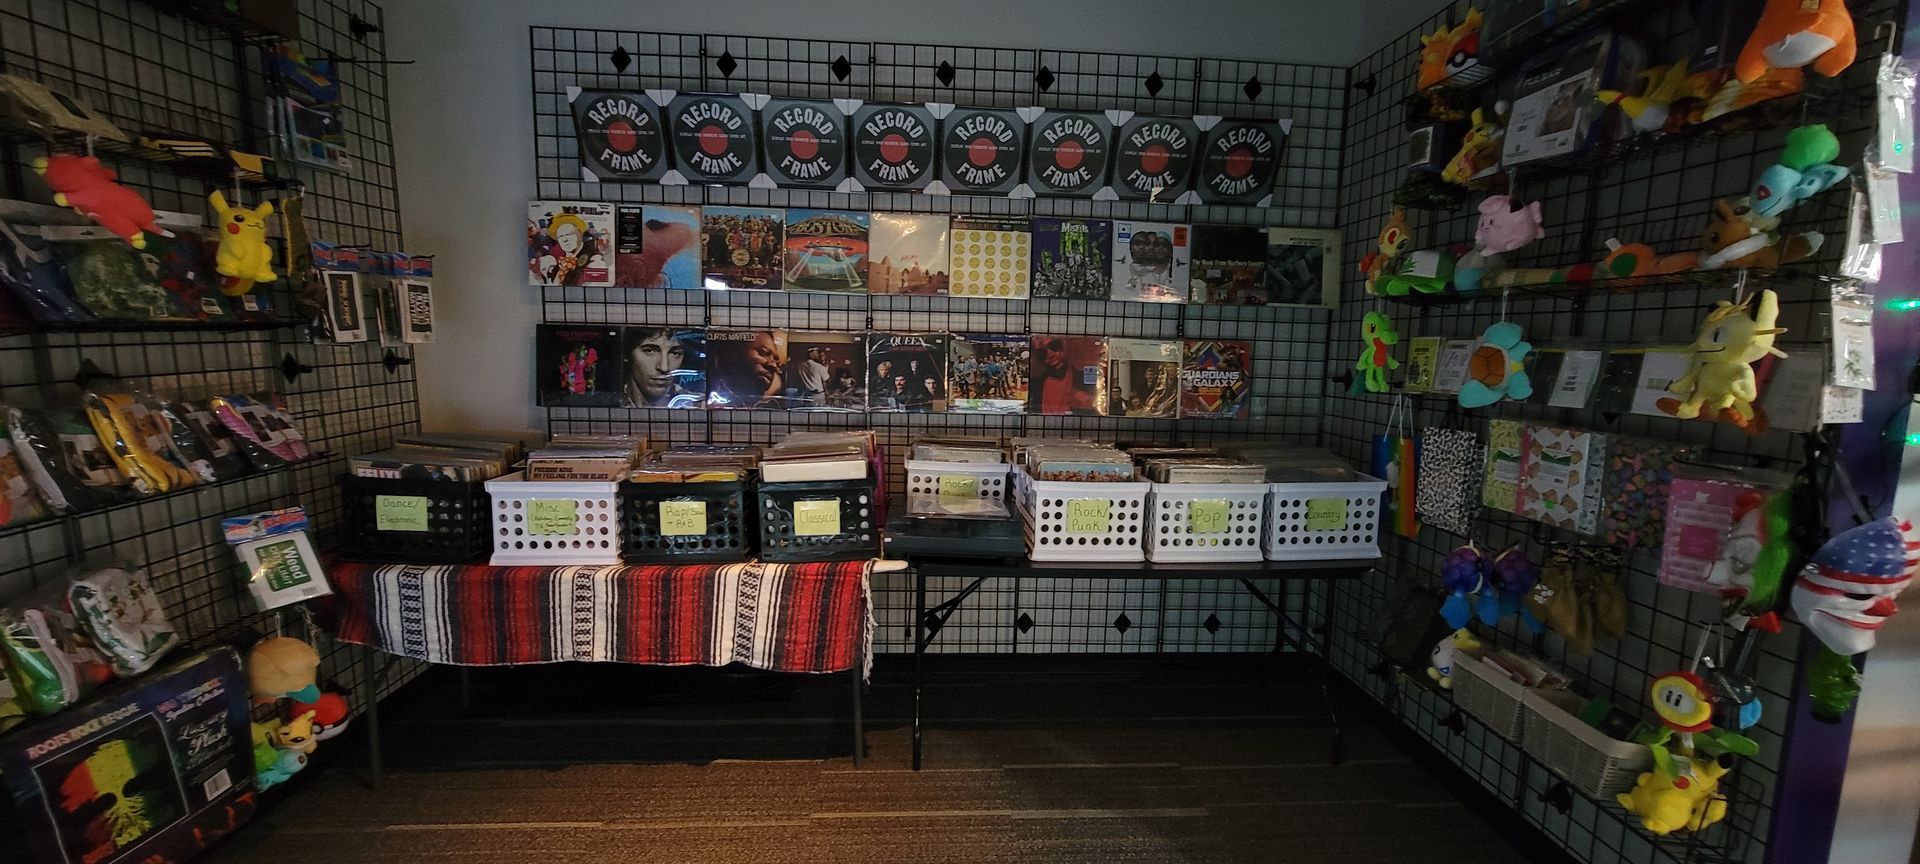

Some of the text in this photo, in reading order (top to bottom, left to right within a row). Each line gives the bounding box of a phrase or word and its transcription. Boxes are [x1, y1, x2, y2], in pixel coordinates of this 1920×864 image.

[588, 99, 649, 127] RECORD
[681, 102, 742, 130] RECORD
[774, 107, 833, 135] RECORD
[865, 111, 924, 139] RECORD
[955, 114, 1013, 143] RECORD
[1043, 118, 1101, 146] RECORD
[1131, 123, 1187, 150] RECORD
[1217, 127, 1271, 154] RECORD
[600, 148, 653, 172] FRAME
[690, 151, 743, 174] FRAME
[780, 154, 831, 178] FRAME
[869, 158, 920, 181] FRAME
[956, 162, 1006, 185] FRAME
[1042, 165, 1091, 187] FRAME
[1127, 169, 1175, 191] FRAME
[1211, 173, 1258, 195] FRAME
[707, 333, 728, 341] CURTIS
[890, 336, 927, 347] QUEEN
[1182, 369, 1240, 380] GUARDIANS
[1193, 379, 1238, 388] GALAXY
[800, 506, 837, 524] Classical
[1074, 502, 1109, 518] Rock/
[1195, 508, 1221, 530] Pop
[1307, 508, 1341, 525] Country
[1072, 519, 1102, 532] Punk
[281, 546, 308, 580] Weed
[278, 565, 293, 585] LIMIT
[26, 702, 141, 760] ROOTS ROCK REGGAE
[188, 723, 228, 756] Plush
